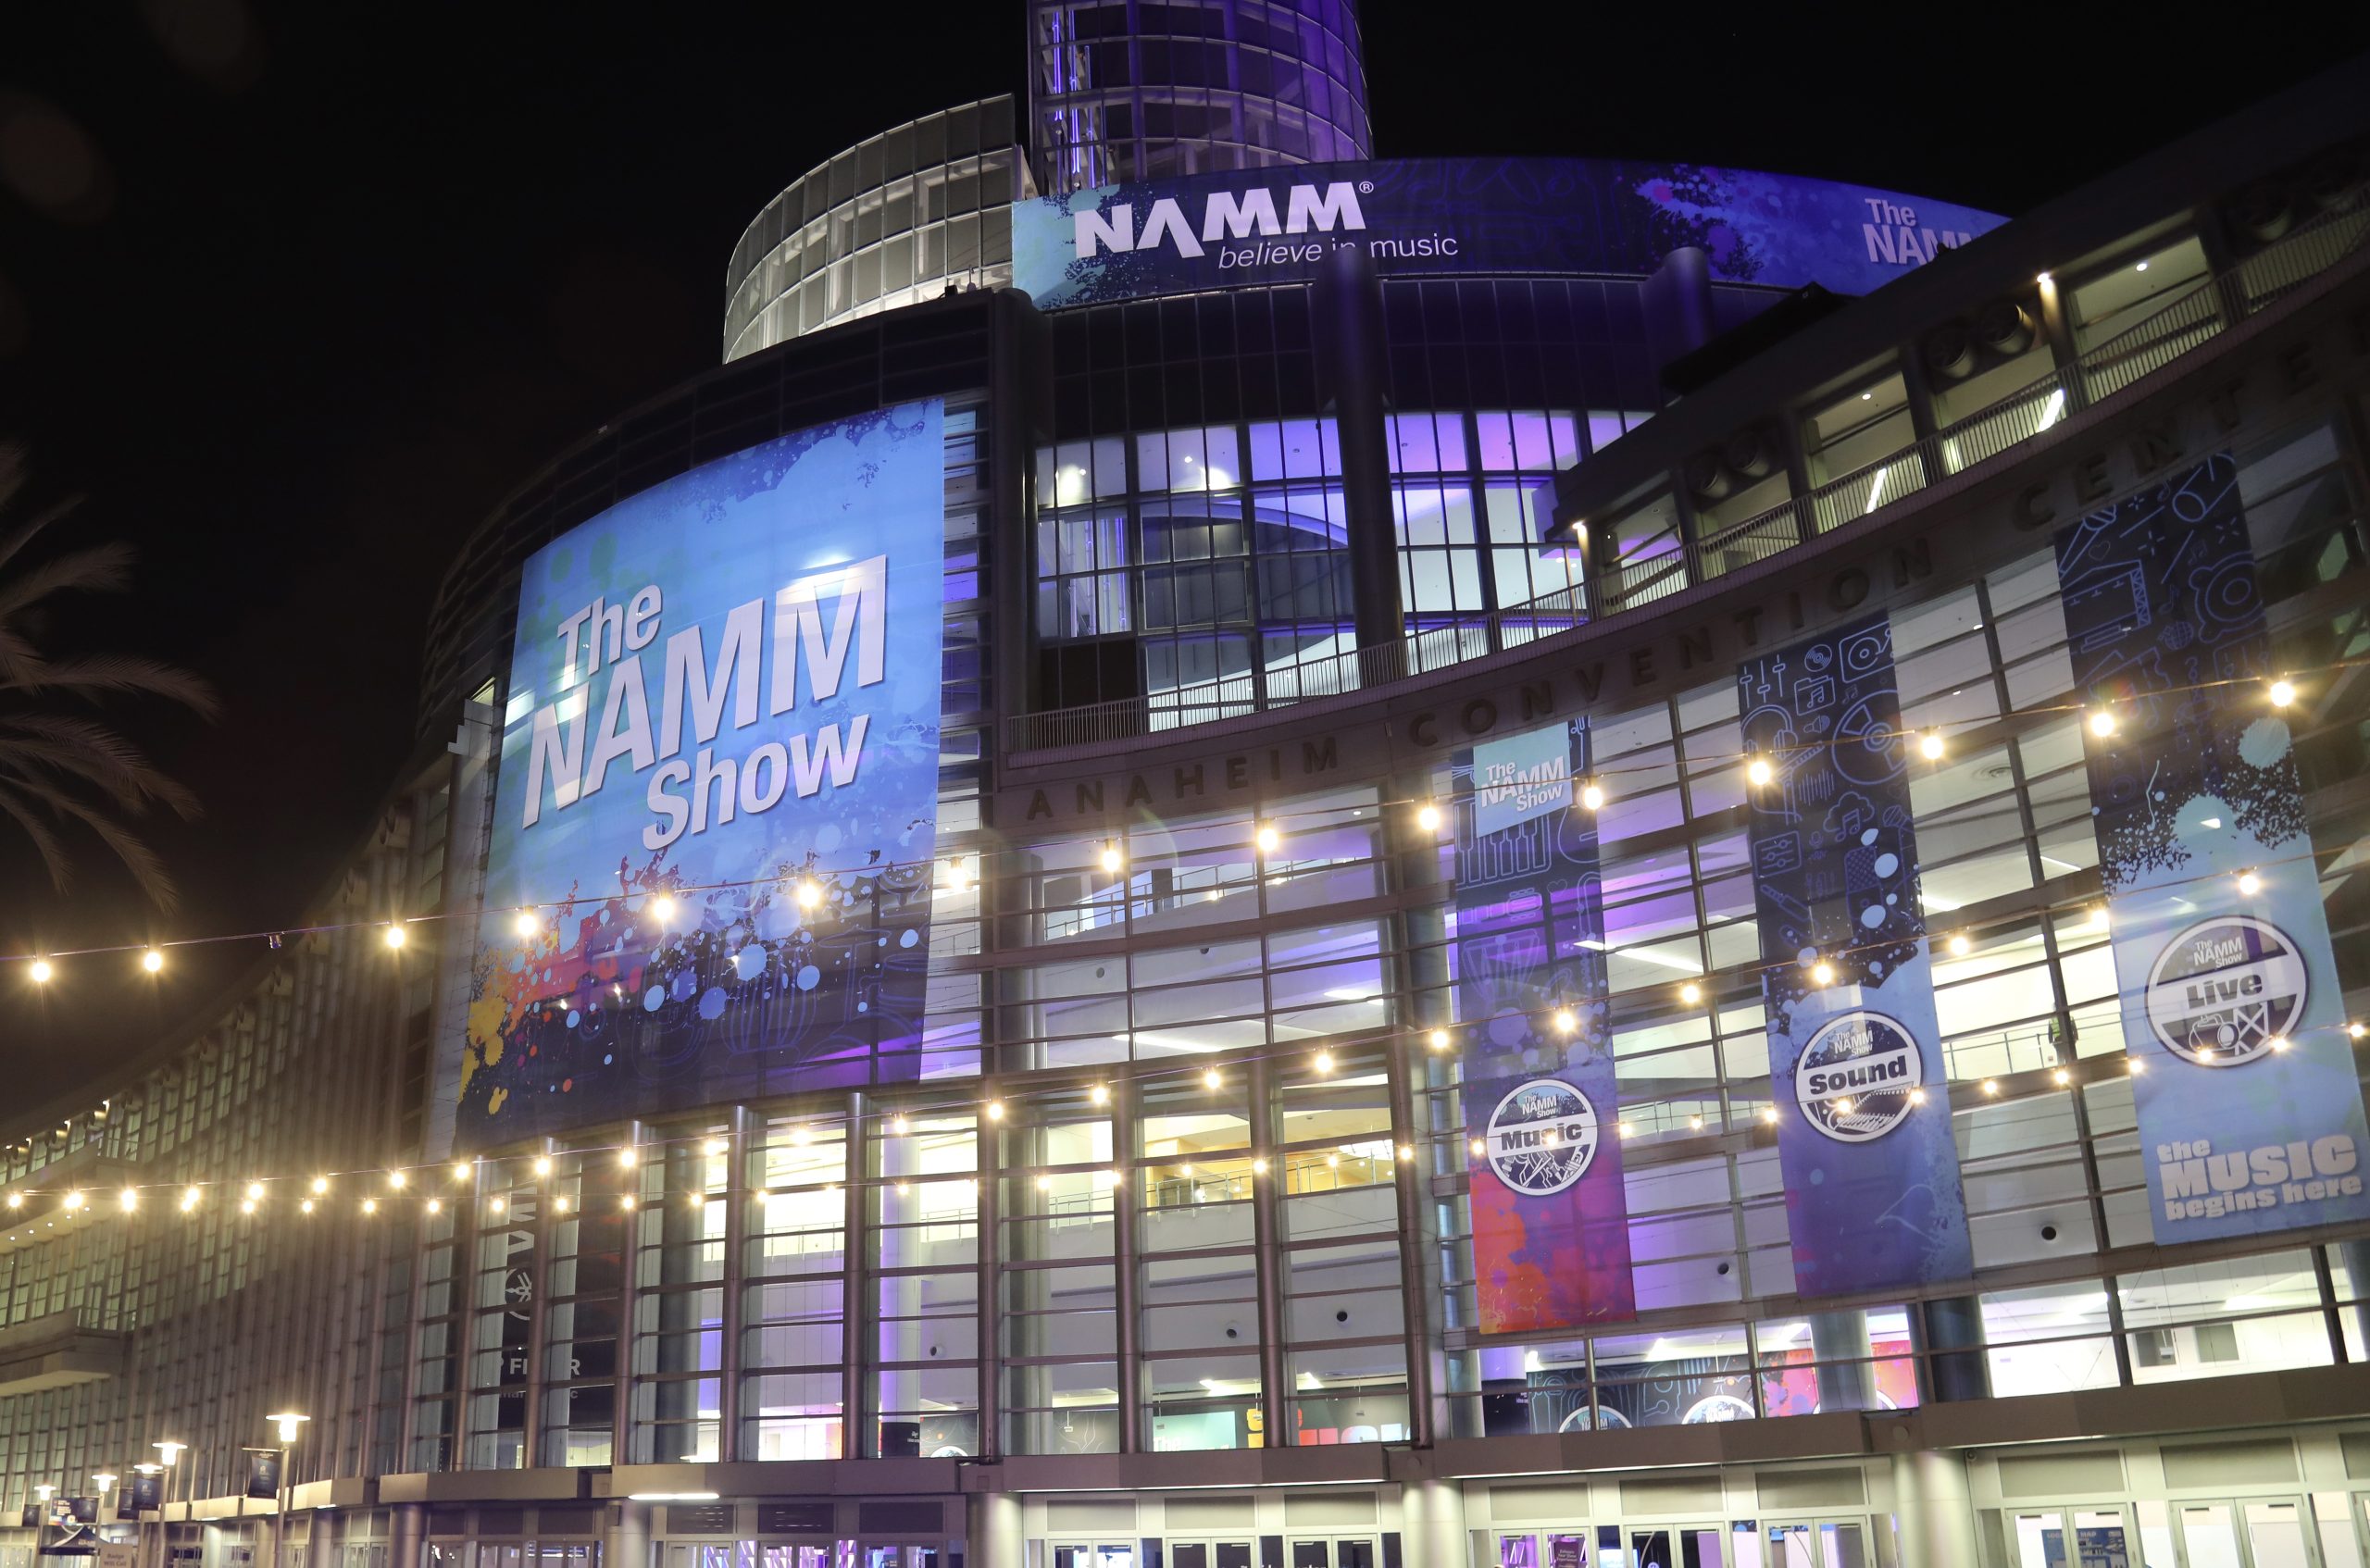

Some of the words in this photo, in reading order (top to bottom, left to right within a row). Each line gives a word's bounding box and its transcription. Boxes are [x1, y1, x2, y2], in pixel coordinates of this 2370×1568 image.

[1865, 198, 1916, 227] The
[1218, 243, 1322, 269] believe
[1370, 232, 1458, 258] music
[1863, 223, 1973, 266] NAM
[557, 584, 662, 691] The
[523, 554, 886, 829] NAMM
[1027, 738, 1339, 821] ANAHEIM
[1410, 538, 1931, 748] CONVENTION
[643, 714, 869, 851] Show
[1481, 755, 1565, 808] NAMM
[1486, 762, 1516, 781] The
[1516, 785, 1563, 812] Show
[2193, 937, 2242, 965] NAMM
[2195, 940, 2213, 952] The
[2215, 953, 2242, 968] Show
[2186, 974, 2263, 1010] Live
[1834, 1030, 1874, 1053] NAMM
[1836, 1031, 1850, 1041] The
[1852, 1044, 1873, 1056] Show
[1809, 1055, 1908, 1095] Sound
[1522, 1096, 1557, 1115] NAMM
[1524, 1095, 1537, 1103] The
[1537, 1109, 1557, 1118] Show
[1501, 1123, 1582, 1151] Music
[2157, 1139, 2211, 1163] the
[2160, 1135, 2357, 1201] MUSIC
[2164, 1188, 2276, 1221] begins
[2282, 1176, 2363, 1204] here
